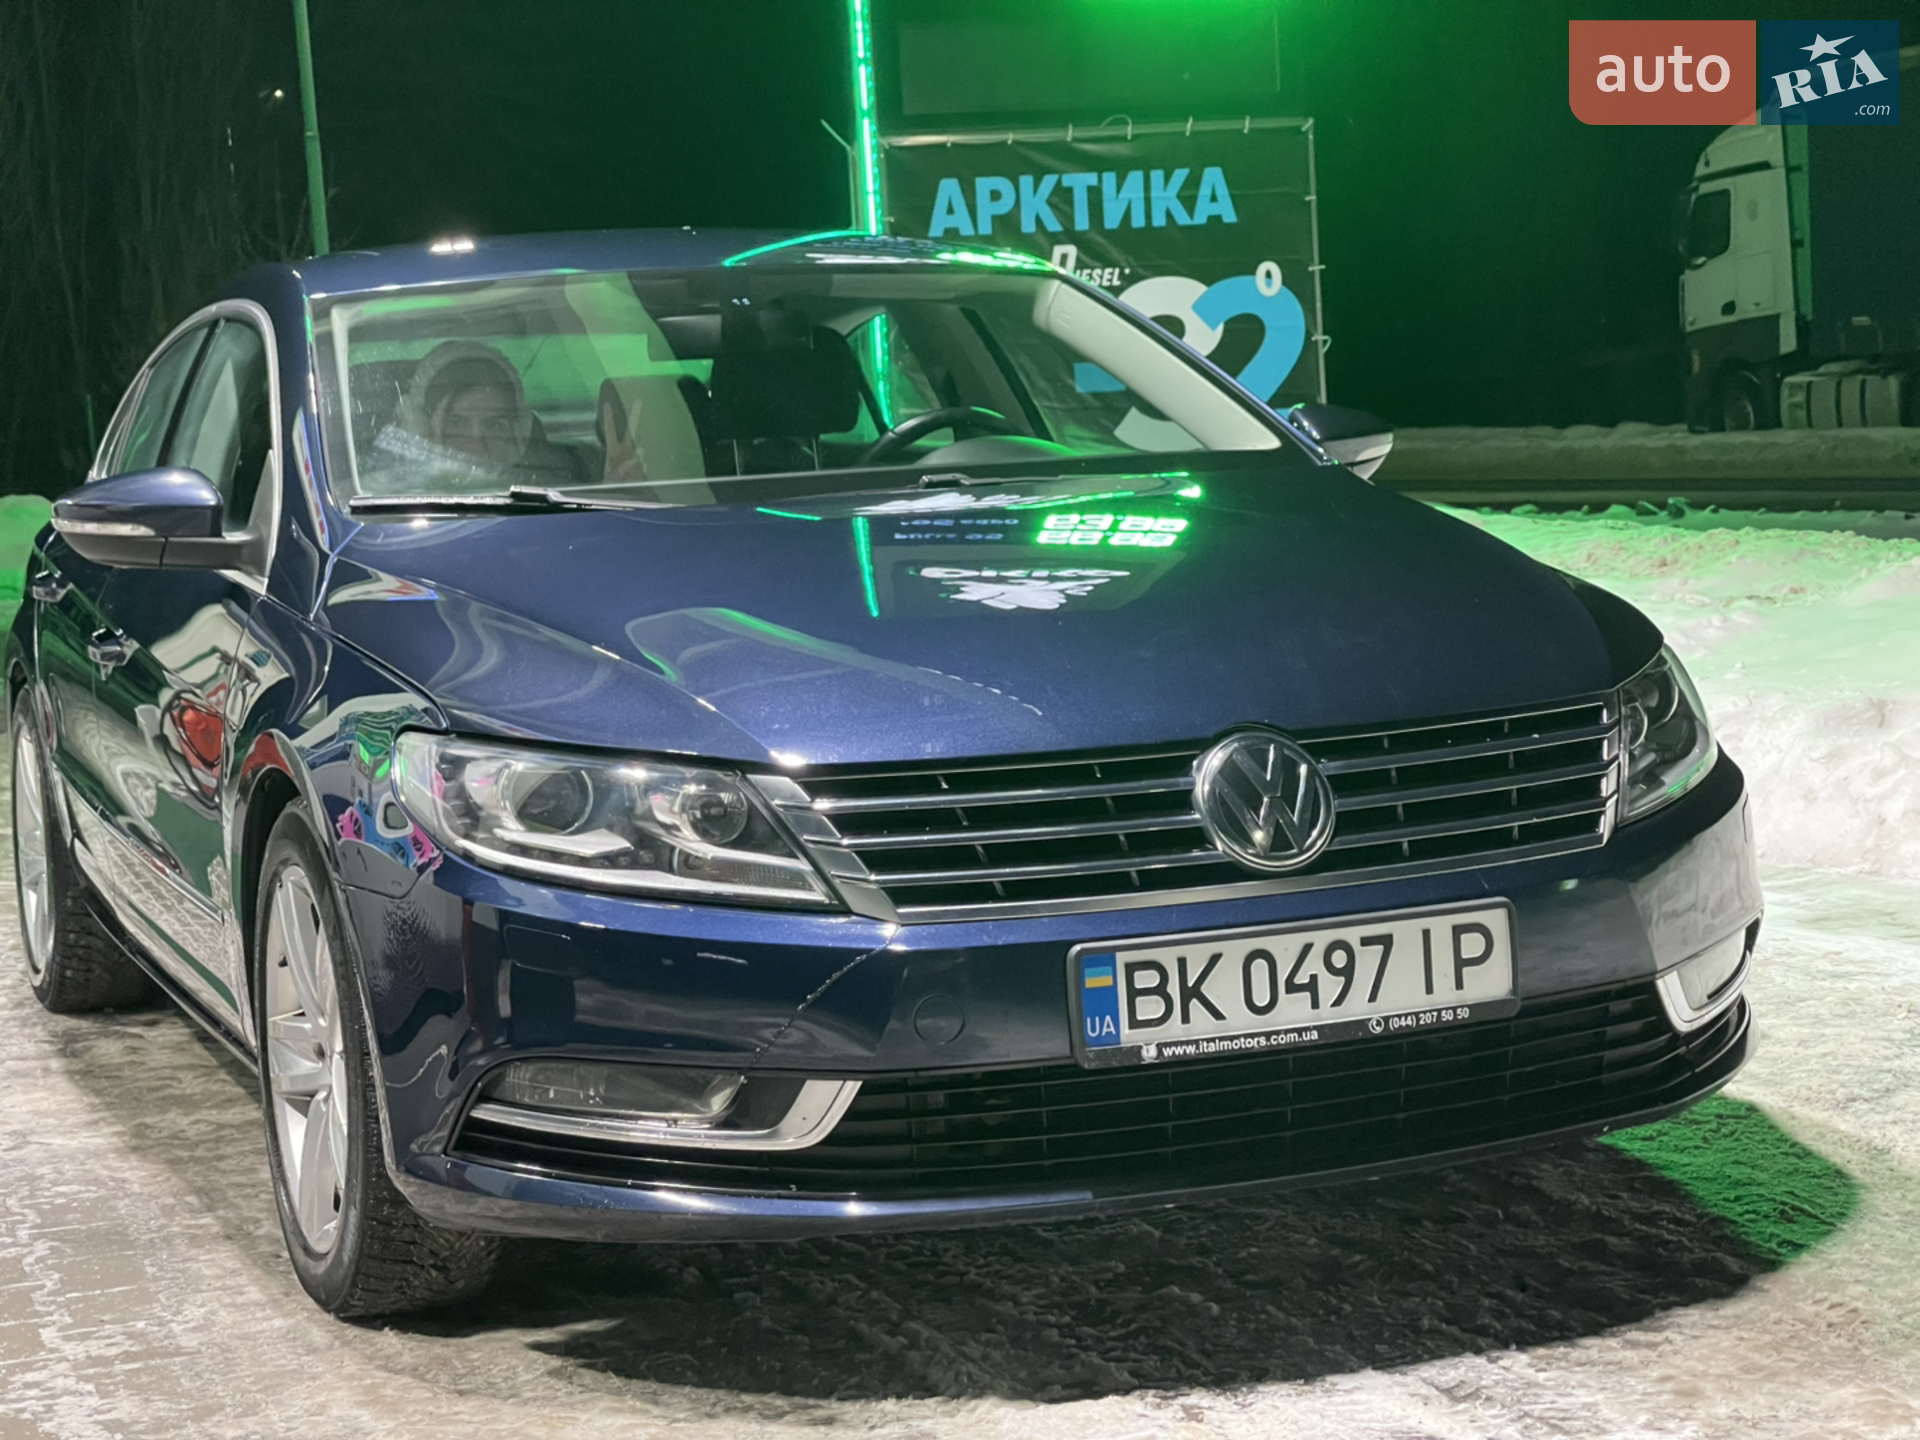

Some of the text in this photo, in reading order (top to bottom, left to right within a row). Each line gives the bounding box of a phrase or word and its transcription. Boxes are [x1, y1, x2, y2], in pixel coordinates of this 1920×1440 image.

[928, 166, 1238, 237] АРКТИКА
[1242, 933, 1394, 1017] 0497
[1421, 922, 1495, 996] IP
[1086, 1014, 1117, 1038] UA
[1388, 1007, 1470, 1031] (044) 207 50 50
[1162, 1029, 1319, 1057] www.italmotors.com.ua
